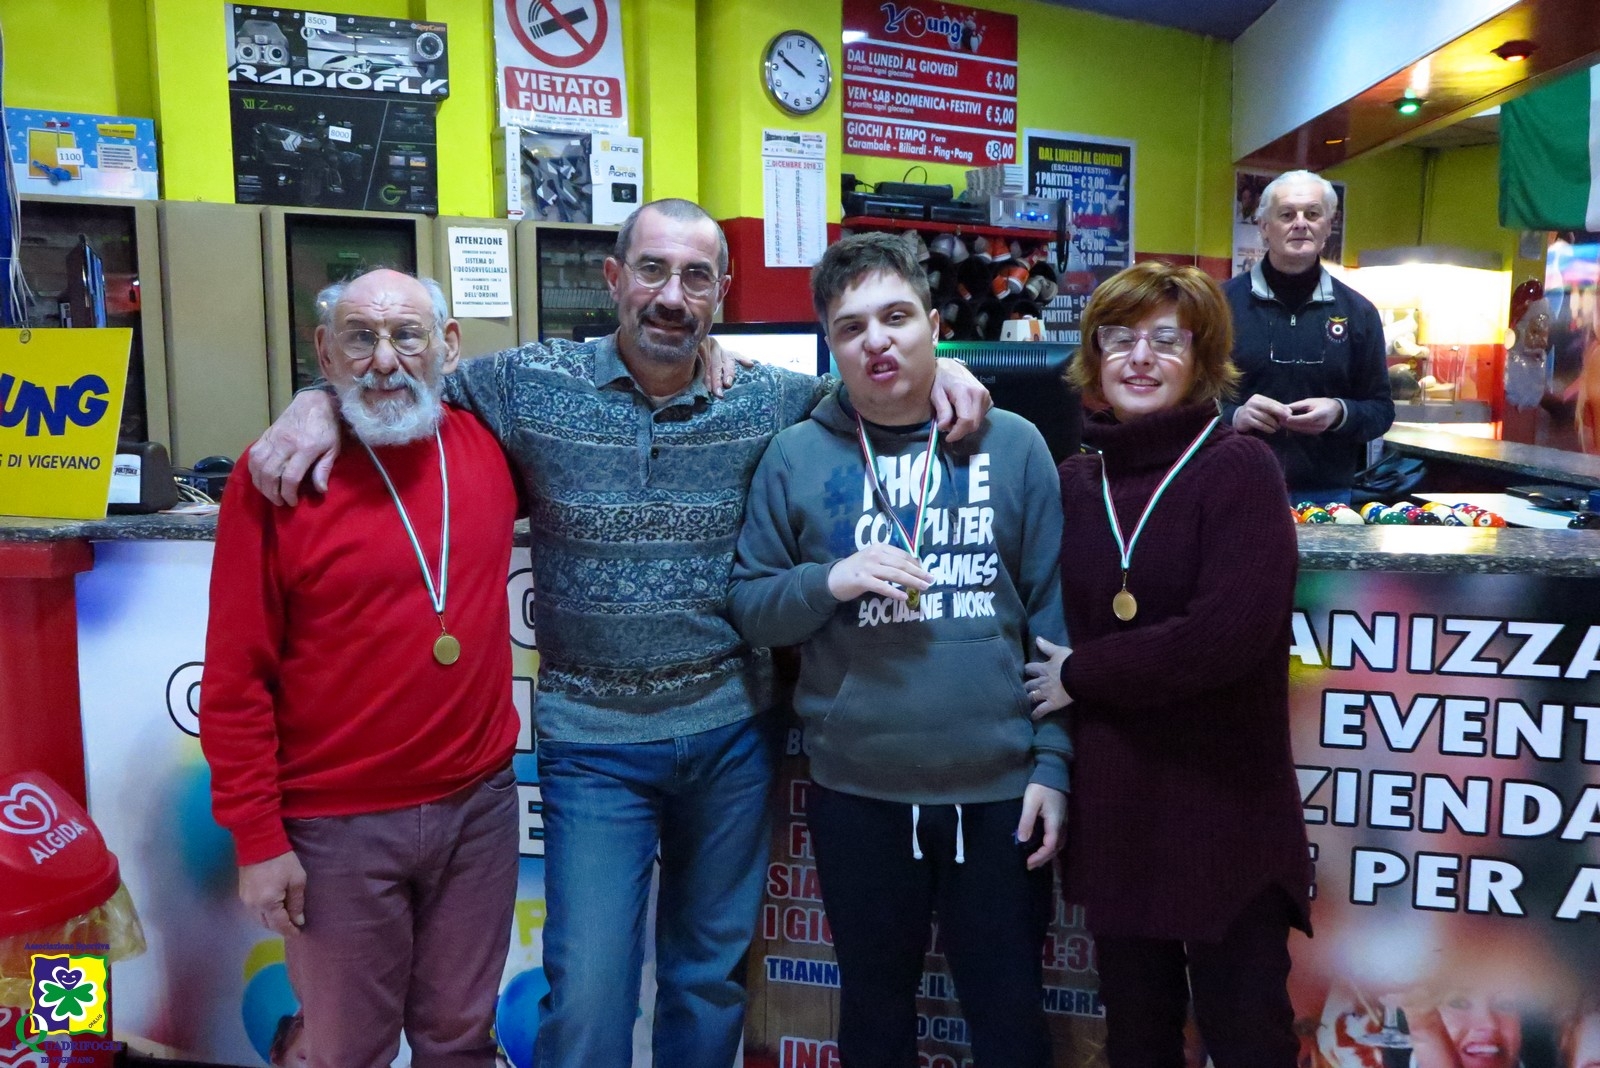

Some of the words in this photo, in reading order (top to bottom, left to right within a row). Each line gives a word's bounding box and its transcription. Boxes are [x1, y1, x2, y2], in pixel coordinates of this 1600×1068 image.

[308, 16, 327, 26] 8500
[848, 49, 866, 64] DAL
[869, 52, 903, 69] LUNEDÌ
[906, 58, 917, 71] AL
[920, 60, 958, 77] GIOVEDÌ
[228, 63, 448, 95] RADIOFLY
[514, 71, 610, 97] VIETATO
[518, 91, 613, 116] FUMARE
[330, 128, 350, 139] 8000
[847, 121, 883, 137] GIOCHI
[885, 126, 892, 139] A
[895, 127, 926, 142] TEMPO
[847, 137, 891, 151] Carambole
[898, 142, 927, 155] Biliardi
[59, 153, 81, 161] 1100
[1038, 146, 1054, 160] DAL
[1083, 151, 1092, 165] AL
[1041, 172, 1073, 187] PARTITA
[455, 236, 503, 246] ATTENZIONE
[453, 266, 508, 274] VIDEOSORVEGLIANZA
[465, 257, 487, 265] SISTEMA
[8, 454, 22, 468] DI
[28, 455, 101, 470] VIGEVANO
[28, 818, 88, 865] ALGIDA
[1350, 847, 1526, 917] PER
[764, 955, 842, 988] TRANN
